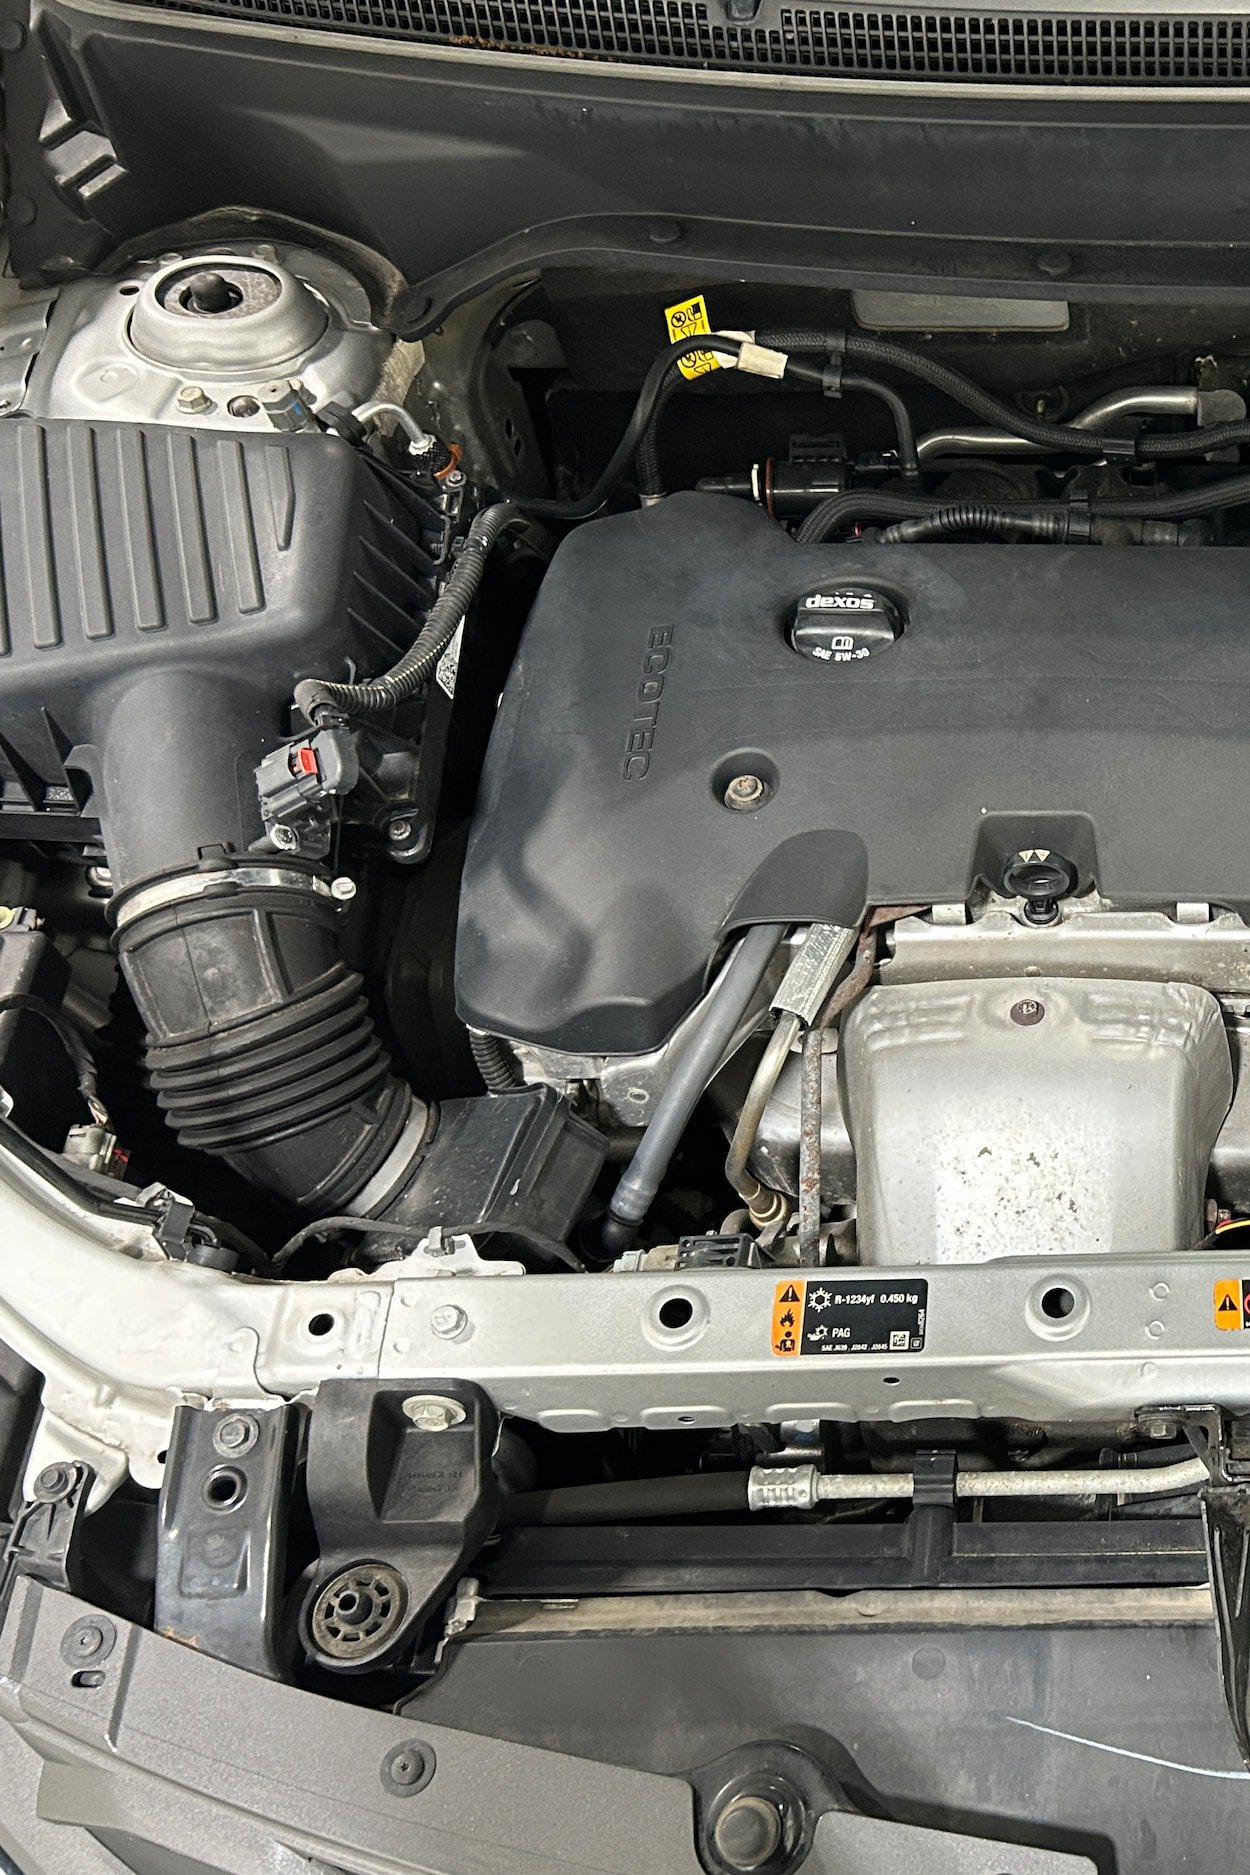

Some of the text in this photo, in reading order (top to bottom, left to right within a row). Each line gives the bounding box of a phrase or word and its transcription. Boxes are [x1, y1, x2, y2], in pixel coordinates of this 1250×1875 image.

[805, 594, 875, 610] dexos
[812, 646, 871, 662] SAE 5W-30
[622, 623, 674, 781] ECOTEC
[834, 1293, 919, 1306] R-1234yf 0.450 kg
[832, 1327, 851, 1338] PAG
